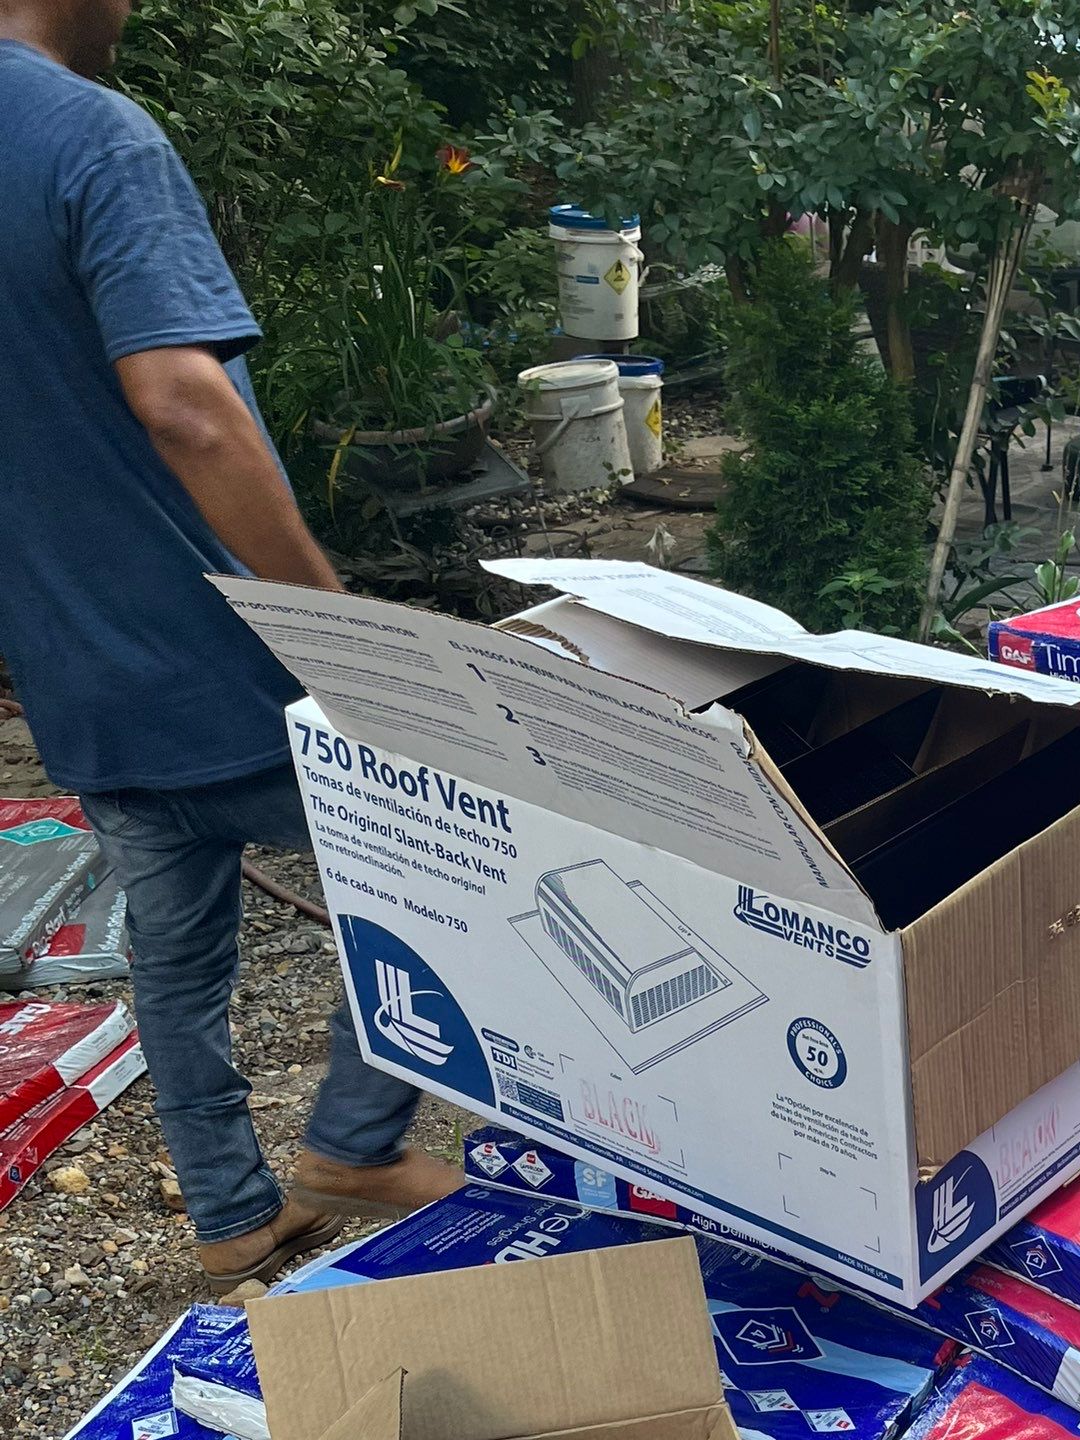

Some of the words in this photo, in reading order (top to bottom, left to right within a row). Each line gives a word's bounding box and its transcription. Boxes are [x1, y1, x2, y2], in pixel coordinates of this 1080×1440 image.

[1001, 645, 1032, 665] GAF
[496, 703, 520, 725] 2
[526, 746, 547, 766] 3
[295, 722, 352, 771] 750
[358, 744, 429, 802] Roof
[434, 773, 512, 833] Vent
[303, 765, 343, 792] Tomas
[346, 782, 361, 798] de
[364, 792, 432, 826] ventilación
[435, 817, 451, 833] de
[454, 824, 490, 848] techo
[492, 838, 517, 858] 750
[310, 794, 335, 817] The
[338, 806, 392, 838] Original
[395, 829, 471, 870] Slant-Back
[472, 859, 507, 884] Vent
[320, 838, 335, 851] con
[326, 826, 349, 842] toma
[363, 840, 410, 866] ventilación
[424, 864, 449, 881] techo
[452, 876, 486, 895] original
[335, 870, 348, 885] de
[351, 878, 375, 896] cada
[376, 888, 398, 905] uno
[404, 898, 445, 924] Modelo
[446, 916, 468, 933] 750
[783, 929, 835, 958] VENTS
[492, 1048, 516, 1070] TDI
[806, 1046, 829, 1067] 50
[805, 1070, 834, 1088] CHOICE
[692, 1214, 717, 1231] High
[838, 1253, 857, 1268] MADE
[876, 1270, 889, 1281] USA
